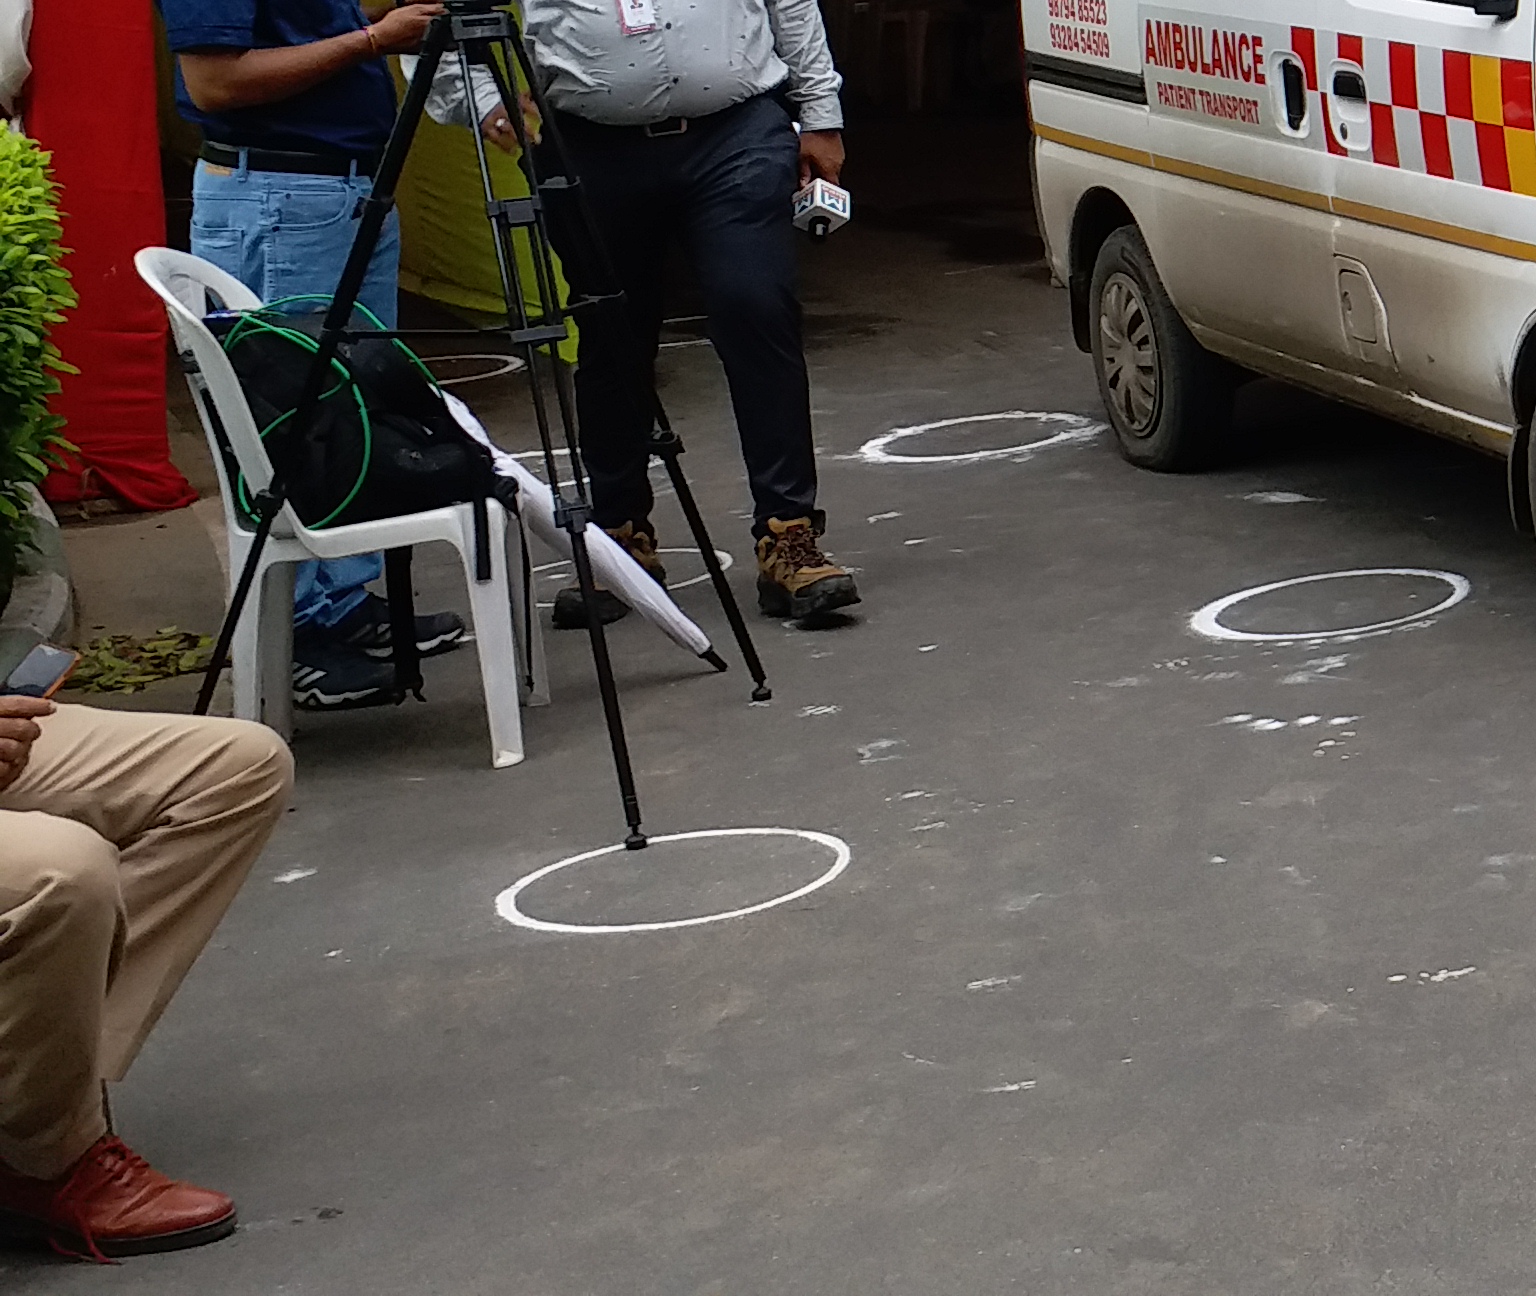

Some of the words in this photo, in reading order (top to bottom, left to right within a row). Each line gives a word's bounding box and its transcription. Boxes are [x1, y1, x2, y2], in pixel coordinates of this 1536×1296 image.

[1145, 18, 1267, 85] AMBULANCE
[1156, 81, 1198, 112] PATIENT
[1198, 89, 1260, 125] TRANSPORT
